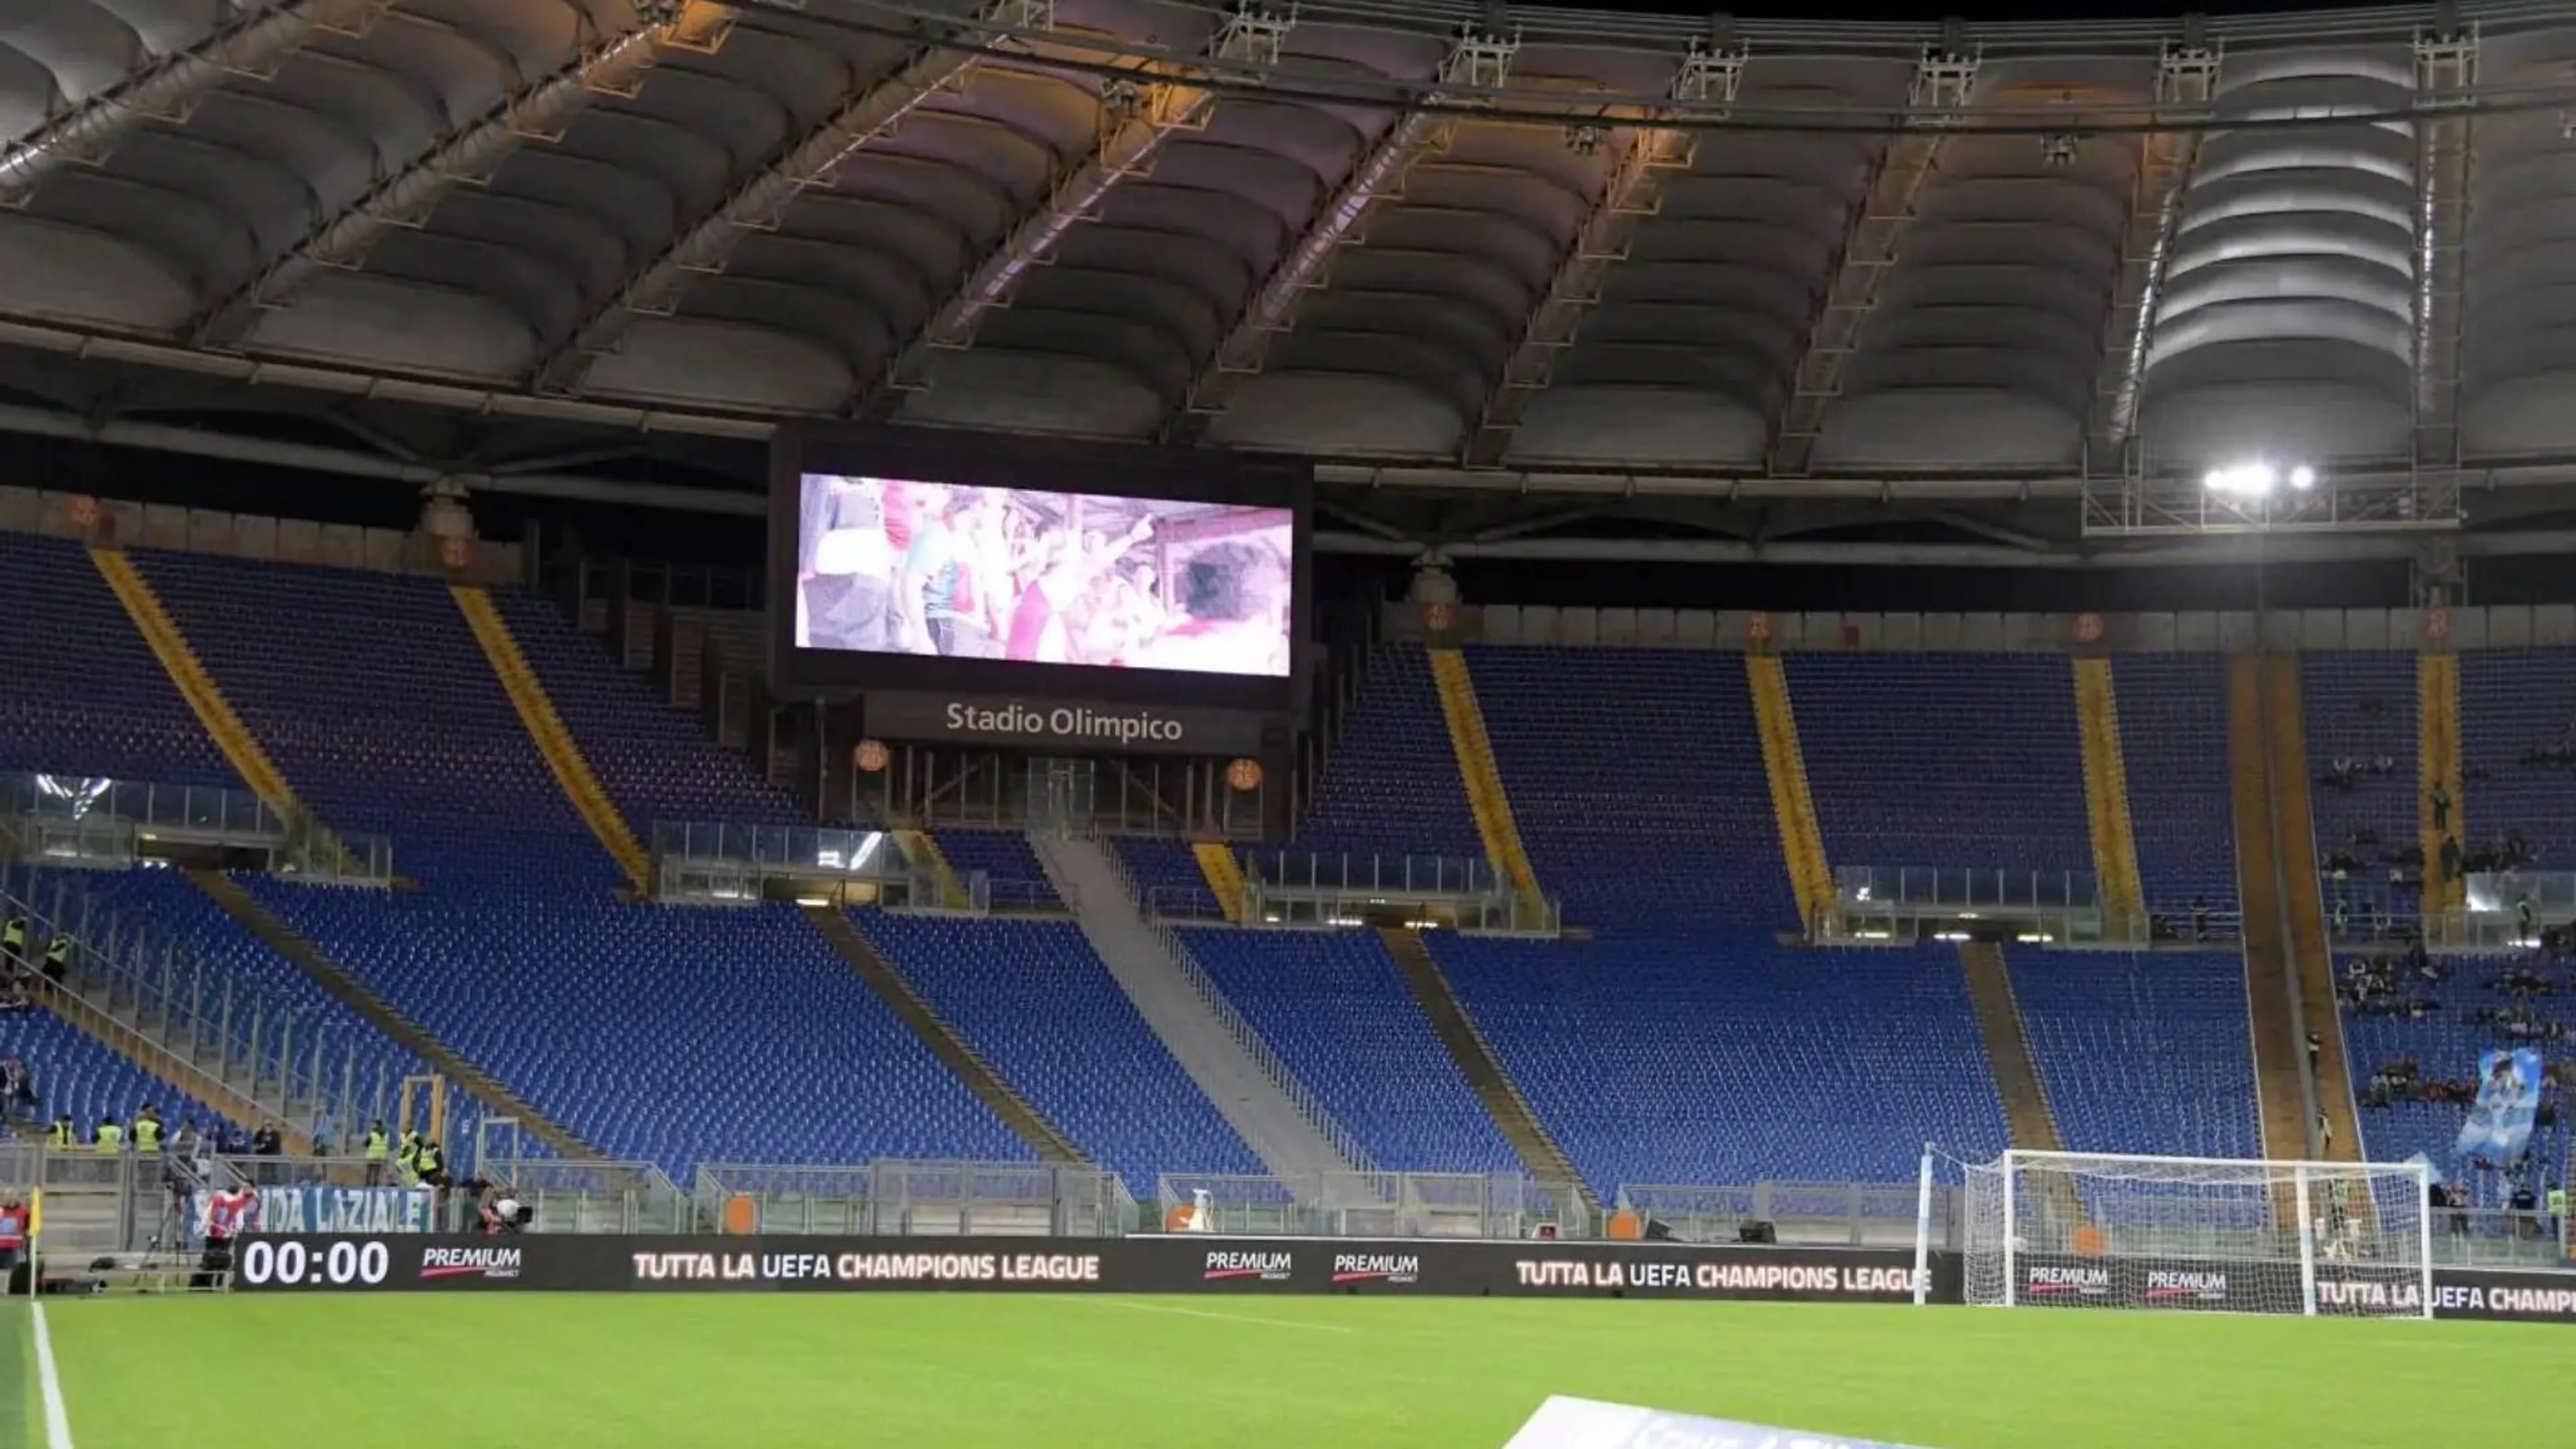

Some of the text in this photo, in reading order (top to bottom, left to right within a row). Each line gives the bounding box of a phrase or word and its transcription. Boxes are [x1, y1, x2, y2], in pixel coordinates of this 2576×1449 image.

[947, 702, 1183, 743] Stadio Olimpico
[244, 1241, 388, 1283] 00:00
[423, 1248, 521, 1267] PREMIUM
[633, 1253, 1099, 1280] TUTTA LA UEFA CHAMPIONS LEAGUE
[1206, 1251, 1291, 1269] PREMIUM
[1334, 1254, 1418, 1272] PREMIUM
[1515, 1260, 1589, 1286] TUTTA
[1595, 1262, 1624, 1286] LA
[1629, 1263, 1691, 1287] UEFA
[1696, 1264, 1838, 1290] CHAMPIONS
[2029, 1267, 2108, 1285] PREMIUM
[2148, 1271, 2226, 1289] PREMIUM
[2316, 1281, 2385, 1305] TUTTA
[2392, 1283, 2419, 1307] LA
